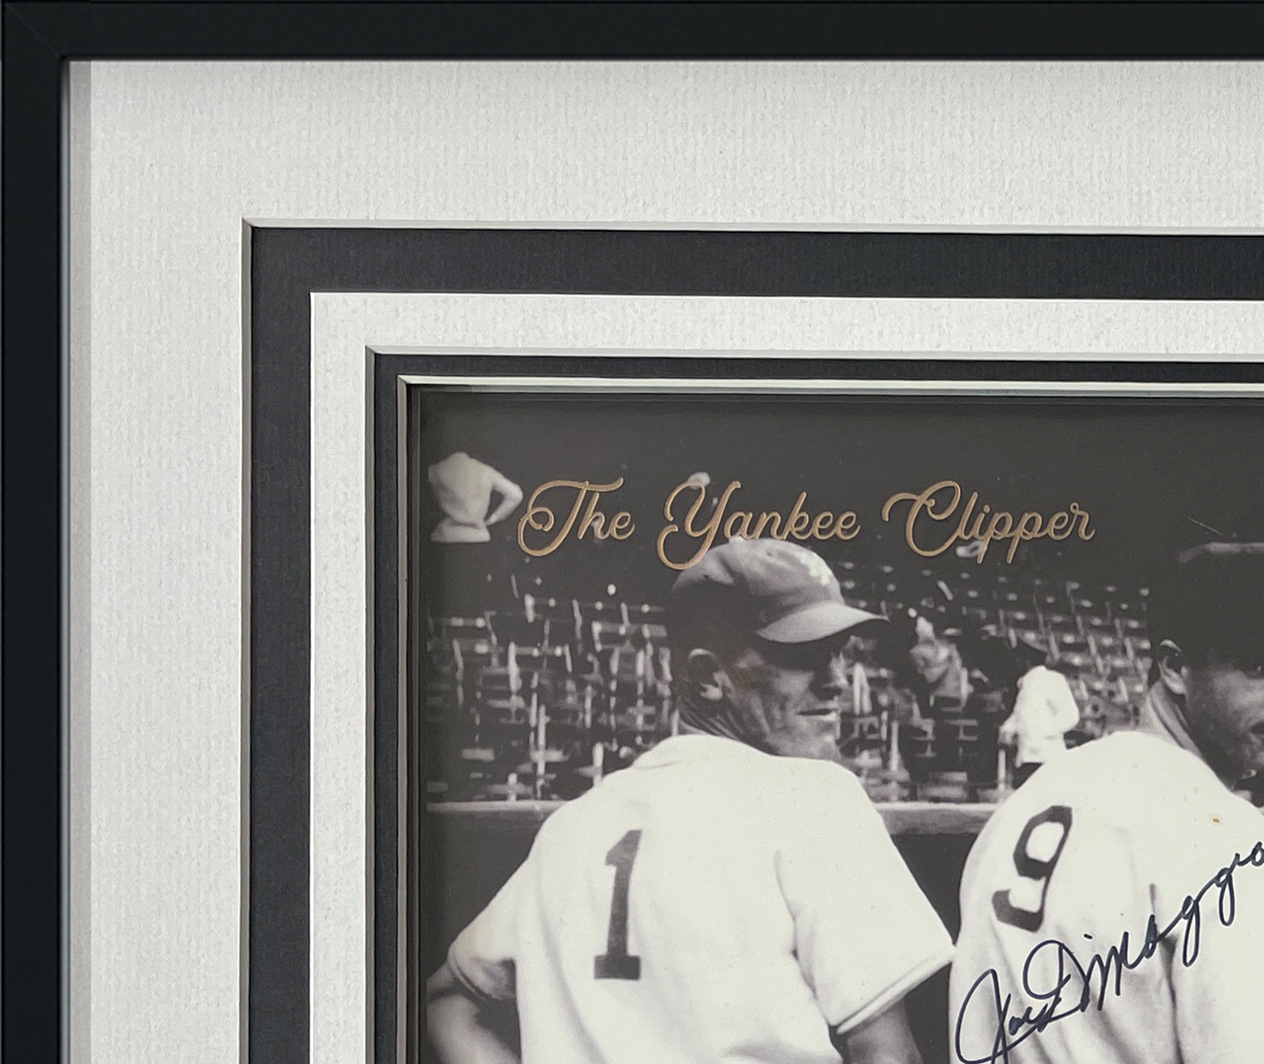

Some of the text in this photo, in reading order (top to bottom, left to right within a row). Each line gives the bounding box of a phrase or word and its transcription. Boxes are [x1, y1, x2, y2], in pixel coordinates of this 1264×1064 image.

[517, 477, 1096, 570] The Yankee Clipper
[594, 829, 643, 980] 1
[991, 805, 1073, 933] 9
